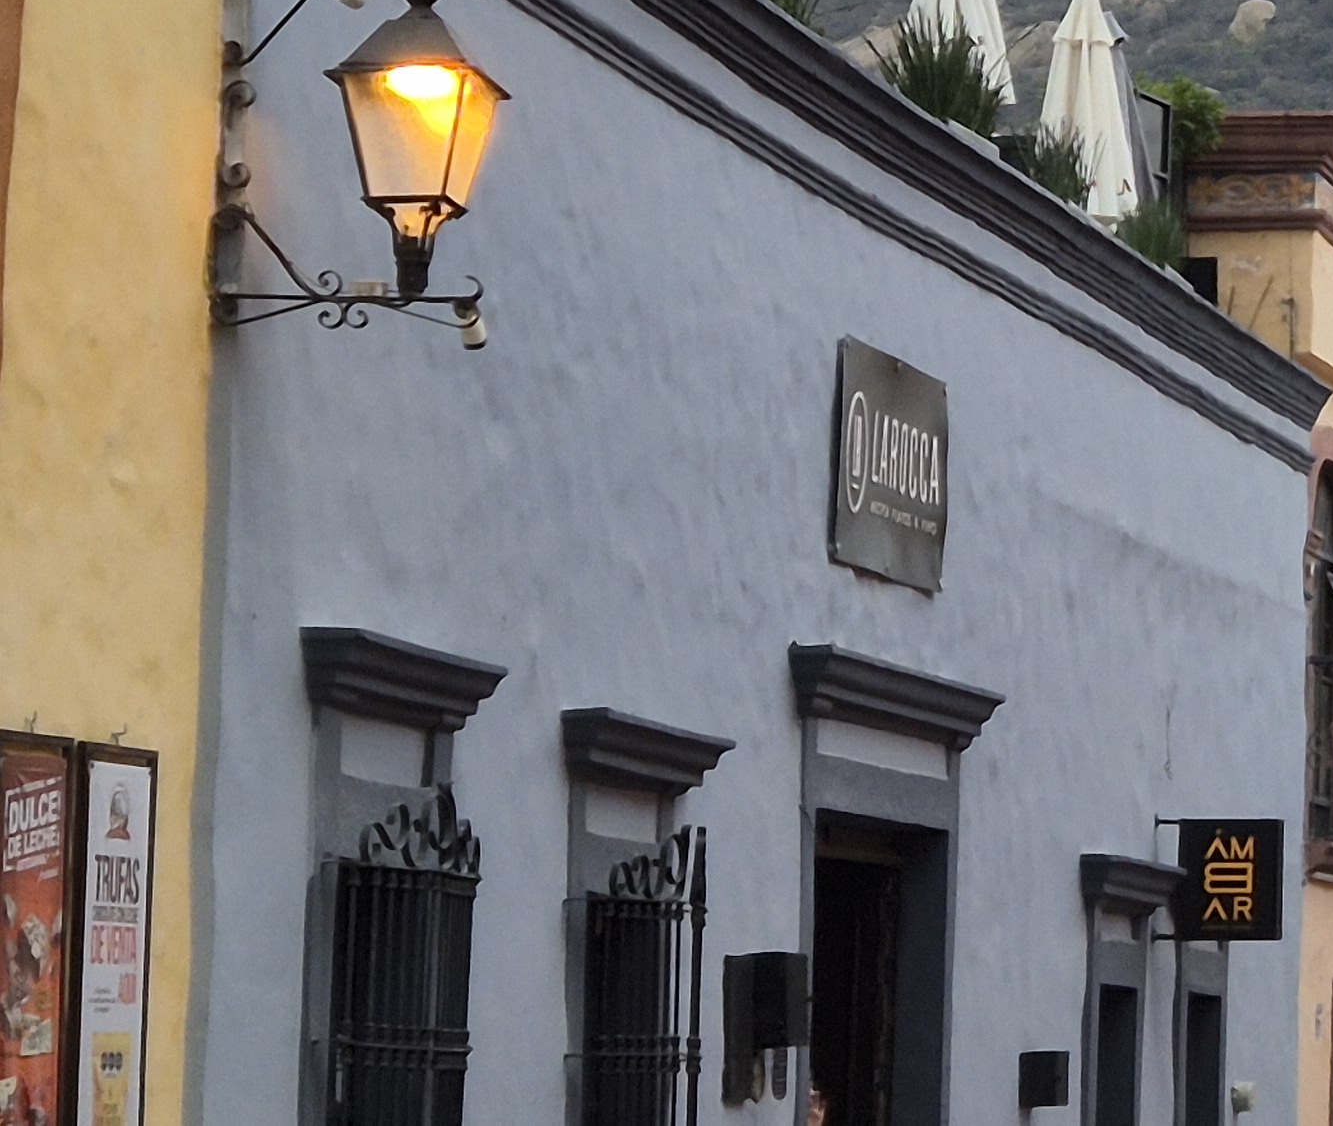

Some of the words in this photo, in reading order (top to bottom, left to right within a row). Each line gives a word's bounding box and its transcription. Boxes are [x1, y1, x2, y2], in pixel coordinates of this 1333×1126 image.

[8, 789, 60, 835] DULCE
[7, 835, 23, 860] DE
[94, 853, 140, 905] TRUFAS
